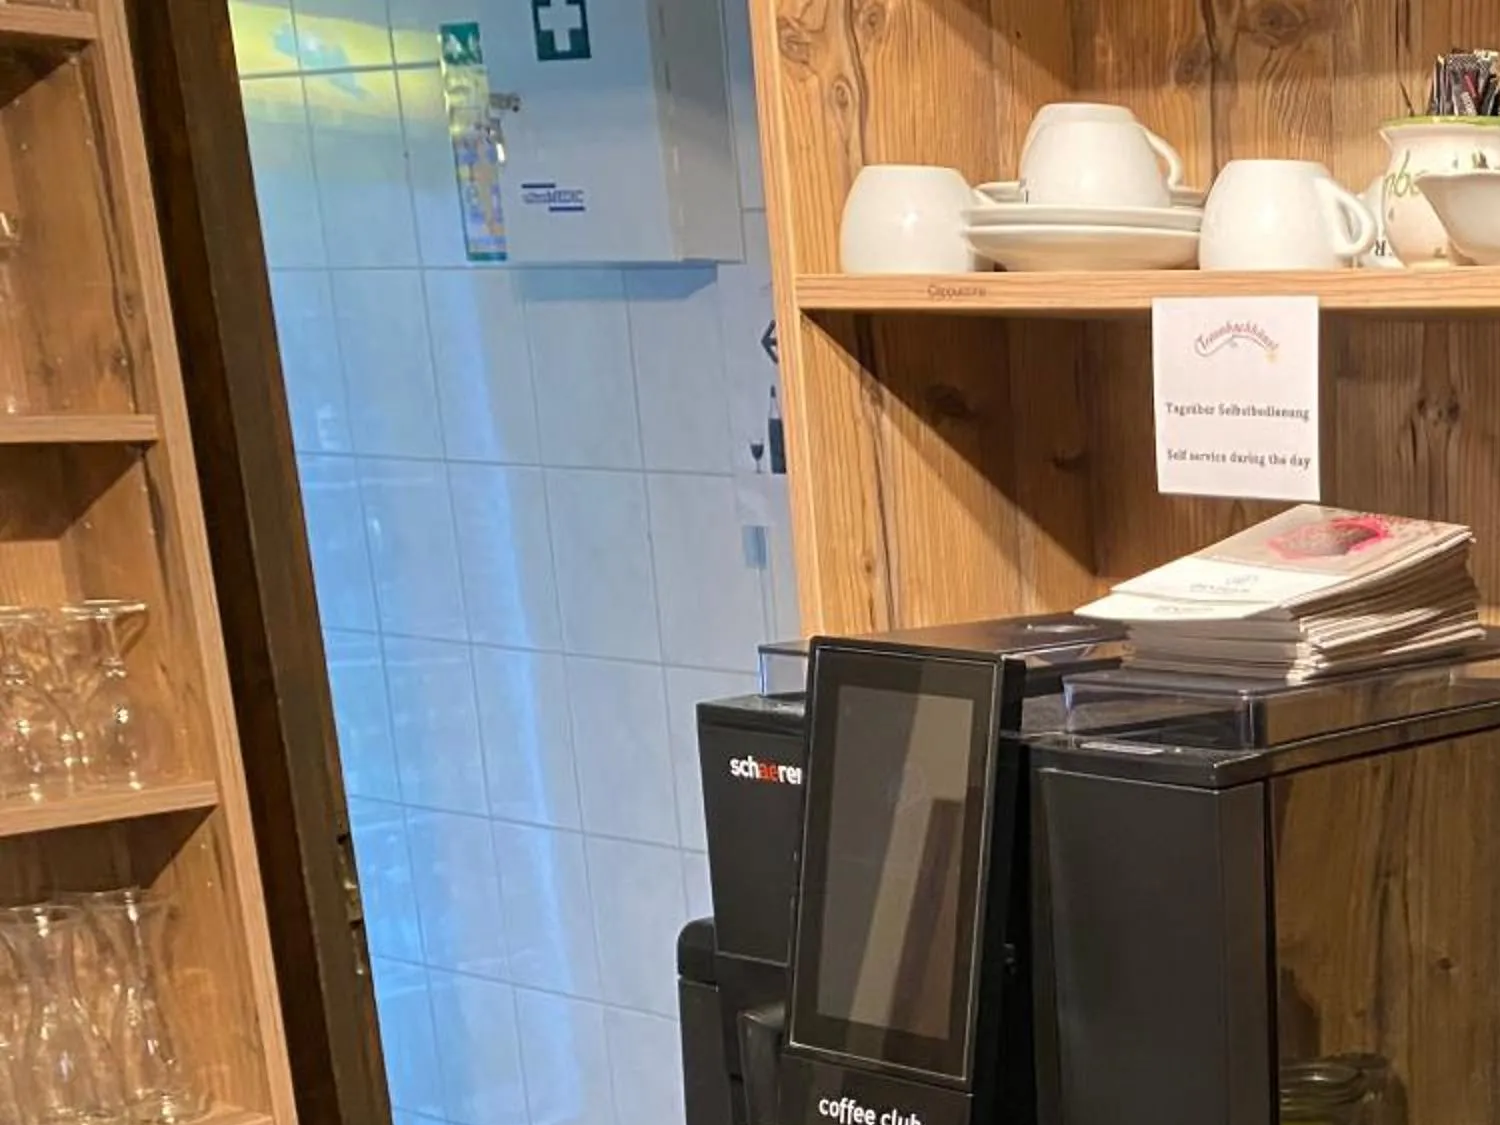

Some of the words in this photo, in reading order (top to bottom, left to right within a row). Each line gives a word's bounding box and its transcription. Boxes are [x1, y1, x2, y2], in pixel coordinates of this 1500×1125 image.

[1218, 403, 1310, 422] Selbstbedienung
[1167, 448, 1187, 461] Self
[1189, 451, 1226, 463] service
[1229, 451, 1265, 468] during
[1268, 453, 1287, 465] the
[1289, 453, 1311, 470] day
